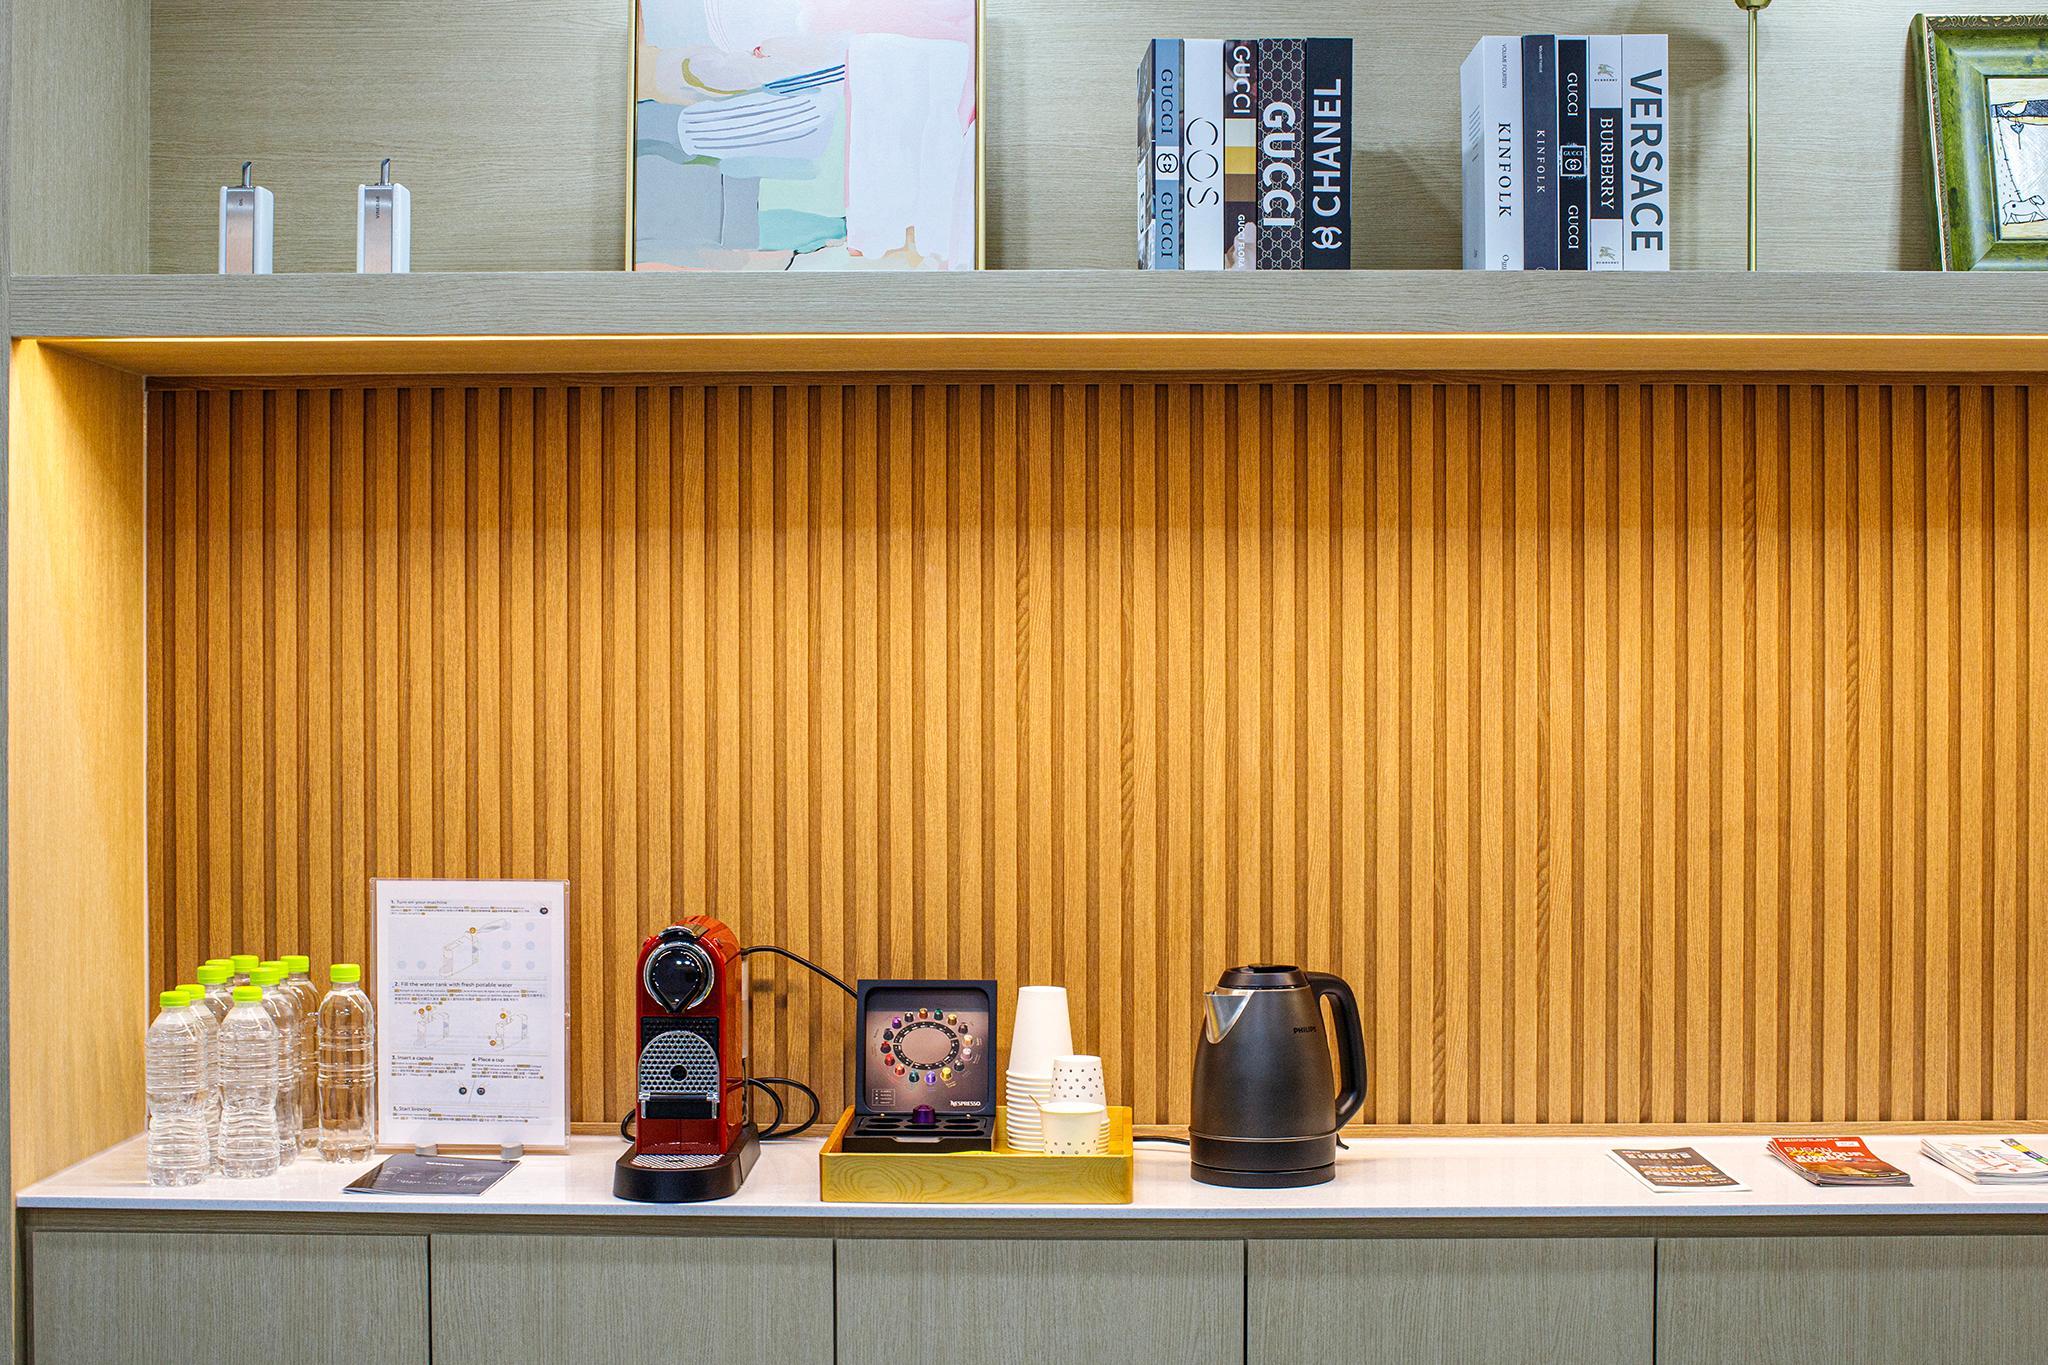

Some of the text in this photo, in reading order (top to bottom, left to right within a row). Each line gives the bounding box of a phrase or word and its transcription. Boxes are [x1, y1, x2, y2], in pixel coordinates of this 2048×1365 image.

[1160, 69, 1174, 135] GUCCI
[1232, 45, 1251, 114] GUCCI
[1566, 72, 1578, 117] GUCCI
[1186, 117, 1219, 209] COS
[1262, 101, 1296, 226] GUCCI
[1312, 78, 1342, 216] CHANEL
[1498, 122, 1512, 218] KINFOLK
[1536, 129, 1546, 193] KINFOLK
[1599, 117, 1615, 210] BURBERRY
[1630, 69, 1664, 251] VERSACE
[1160, 191, 1174, 258] GUCCI
[1237, 214, 1246, 240] GUCCI
[1567, 204, 1580, 250] GUCCI
[1293, 1026, 1317, 1034] PHILIPS
